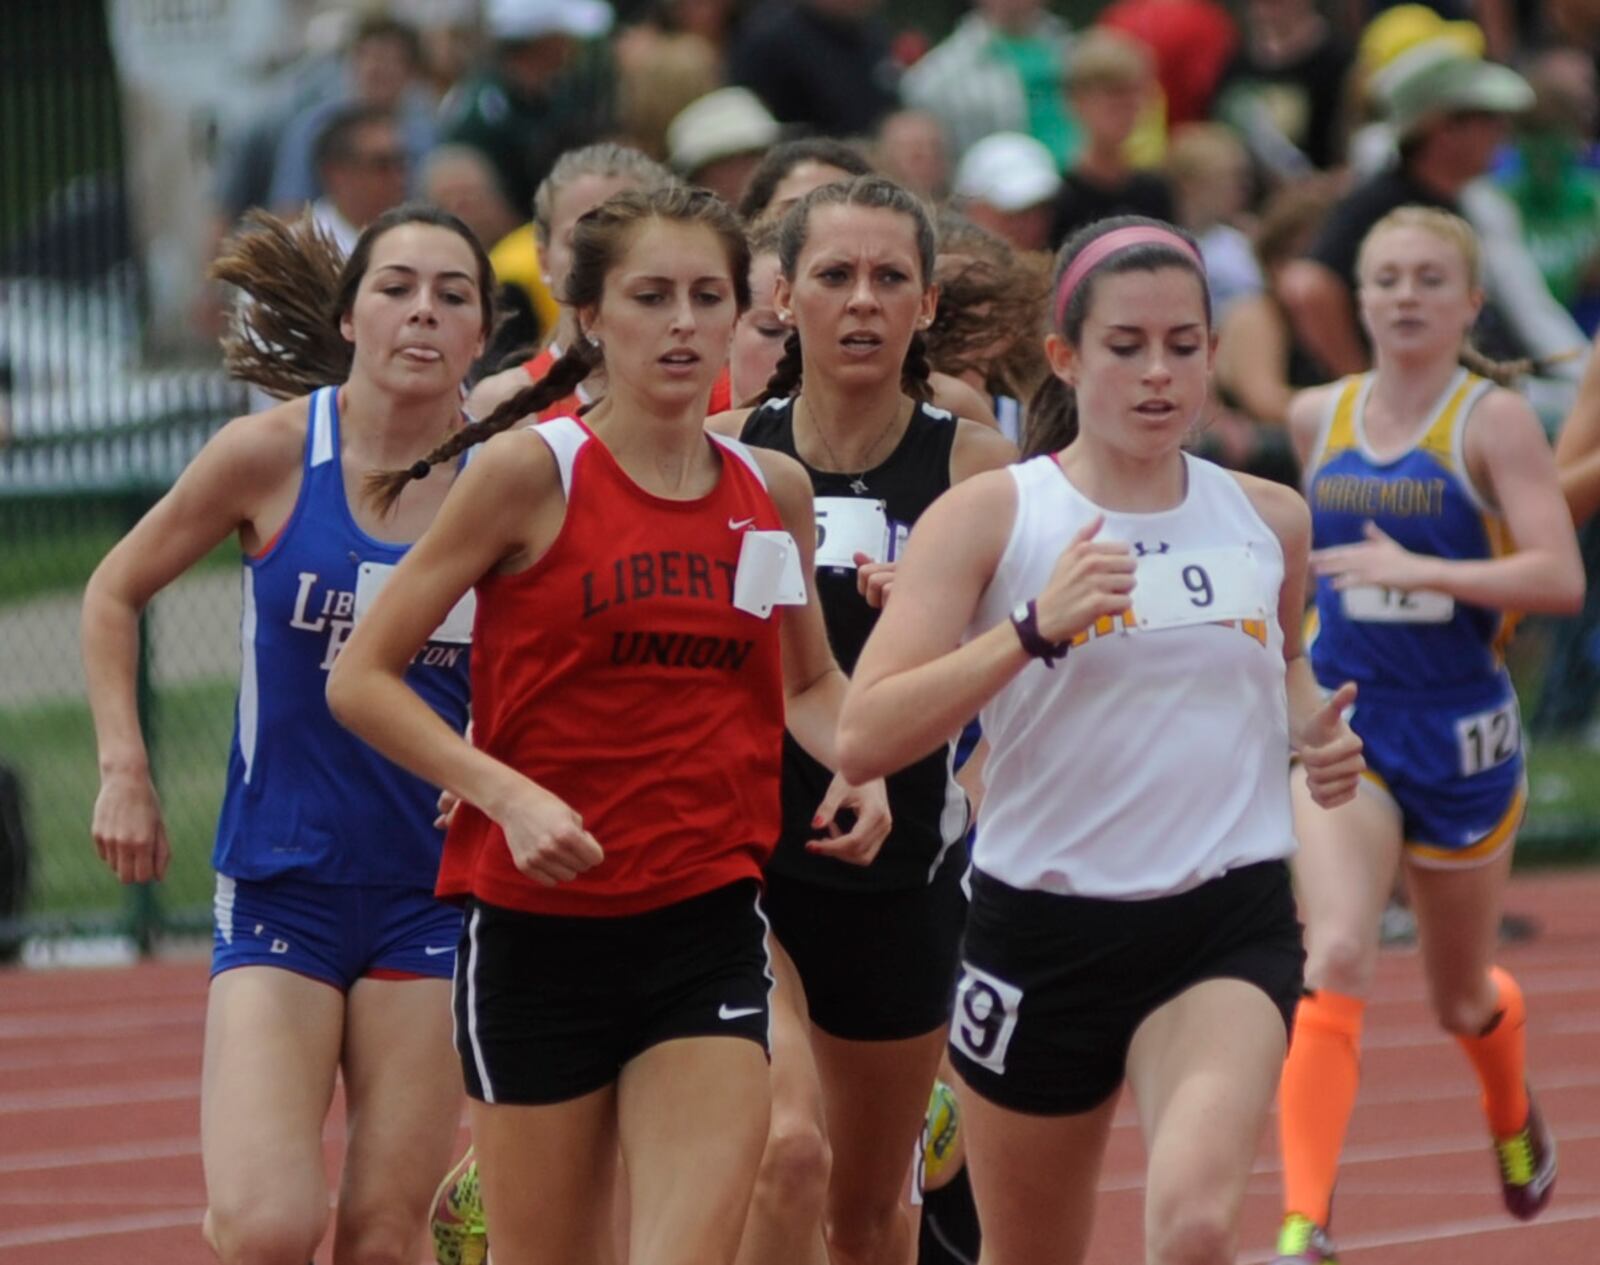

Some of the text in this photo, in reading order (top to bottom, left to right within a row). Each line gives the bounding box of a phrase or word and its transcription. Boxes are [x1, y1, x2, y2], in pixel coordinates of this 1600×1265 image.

[577, 551, 735, 620] LIBERT
[1181, 564, 1215, 608] 9
[609, 631, 754, 671] UNION
[1467, 711, 1513, 769] 12
[962, 980, 1006, 1060] 9
